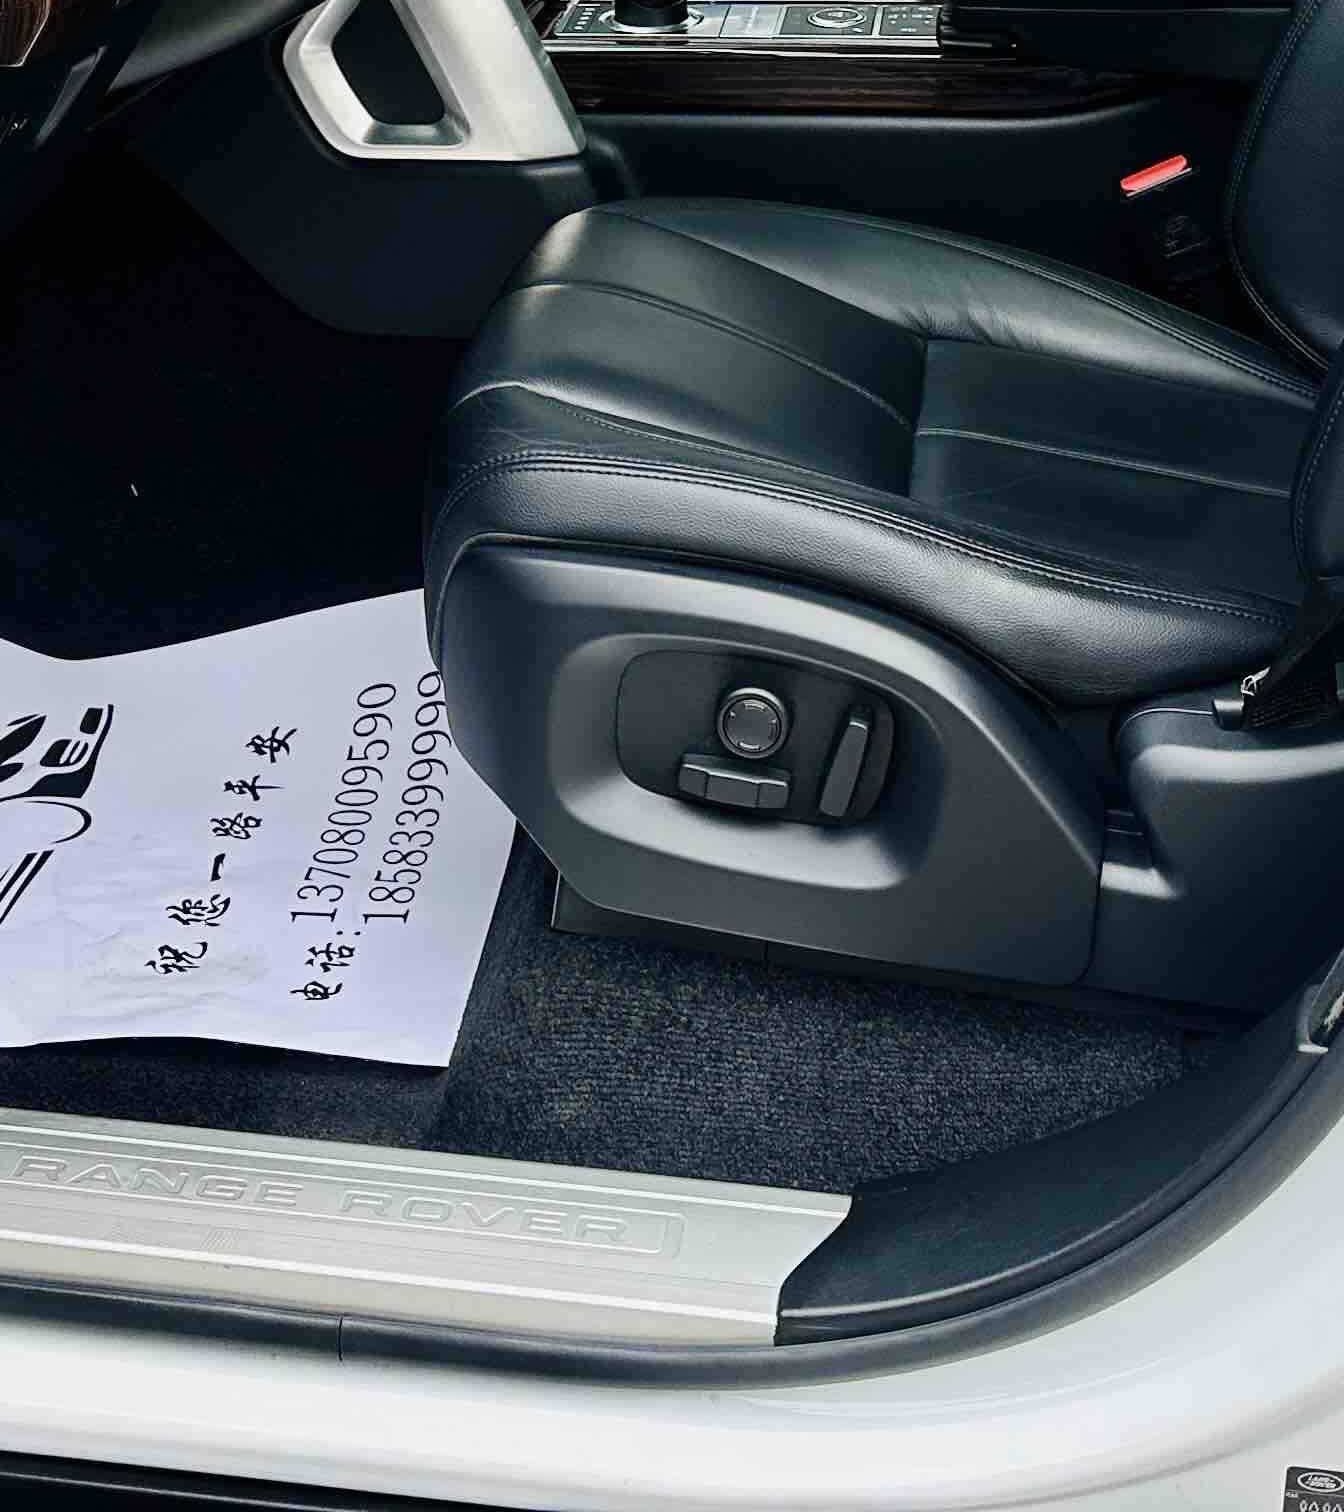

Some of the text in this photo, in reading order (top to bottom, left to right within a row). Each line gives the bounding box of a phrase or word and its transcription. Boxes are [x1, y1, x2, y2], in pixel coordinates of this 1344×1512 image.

[144, 725, 297, 976] 祝您一路平安
[290, 682, 397, 924] 13708009590
[9, 1154, 629, 1240] RANGE ROVER
